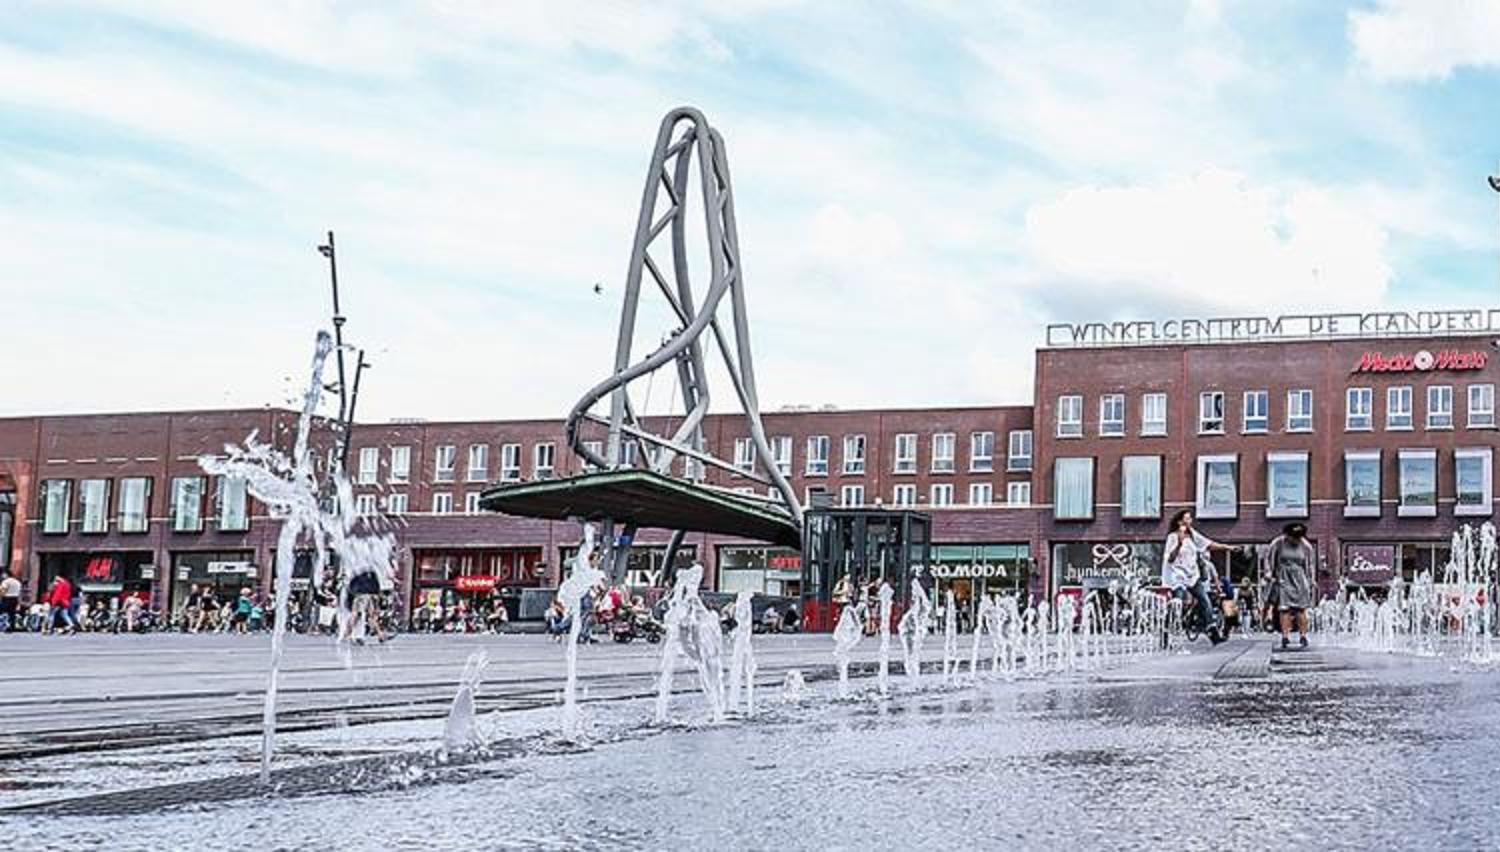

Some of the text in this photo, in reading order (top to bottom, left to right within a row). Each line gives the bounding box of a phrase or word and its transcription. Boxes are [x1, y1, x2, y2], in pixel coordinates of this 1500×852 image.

[1070, 317, 1284, 342] WINKELCENTRUM
[1310, 314, 1338, 333] DE
[950, 563, 1008, 578] MODA
